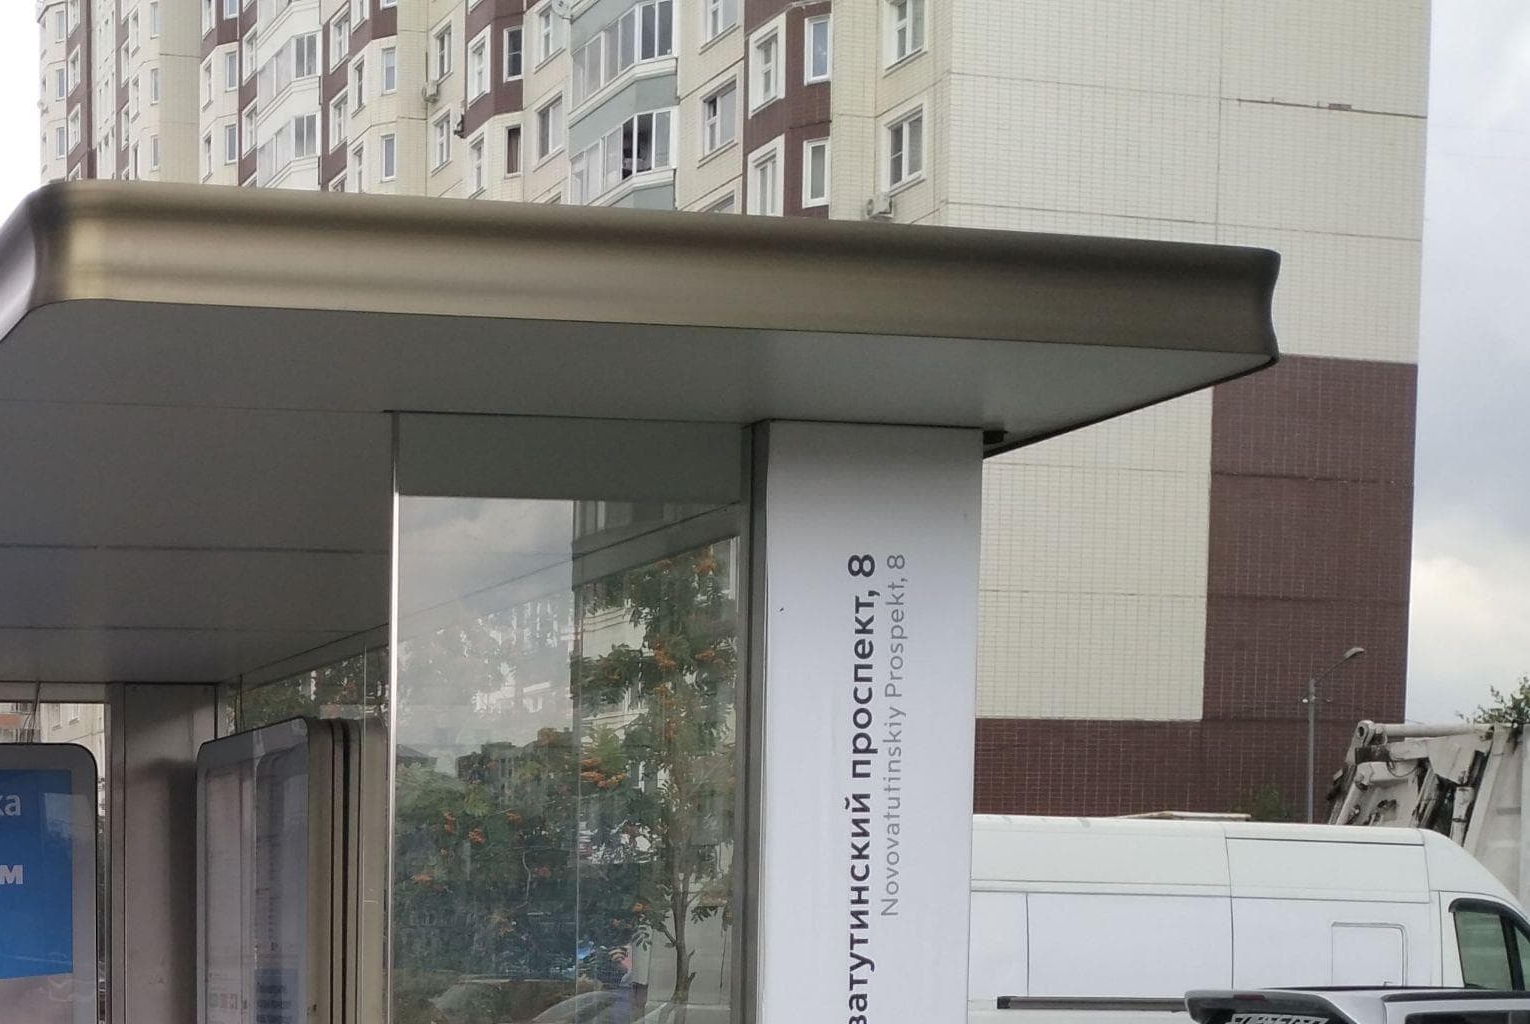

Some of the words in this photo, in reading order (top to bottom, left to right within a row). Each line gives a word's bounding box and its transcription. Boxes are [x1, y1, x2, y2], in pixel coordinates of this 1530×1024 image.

[848, 554, 876, 578] 8
[886, 554, 906, 570] 8
[851, 590, 881, 778] проспект,
[885, 577, 909, 698] Prospekt,
[881, 705, 907, 917] Novovatutinskiy
